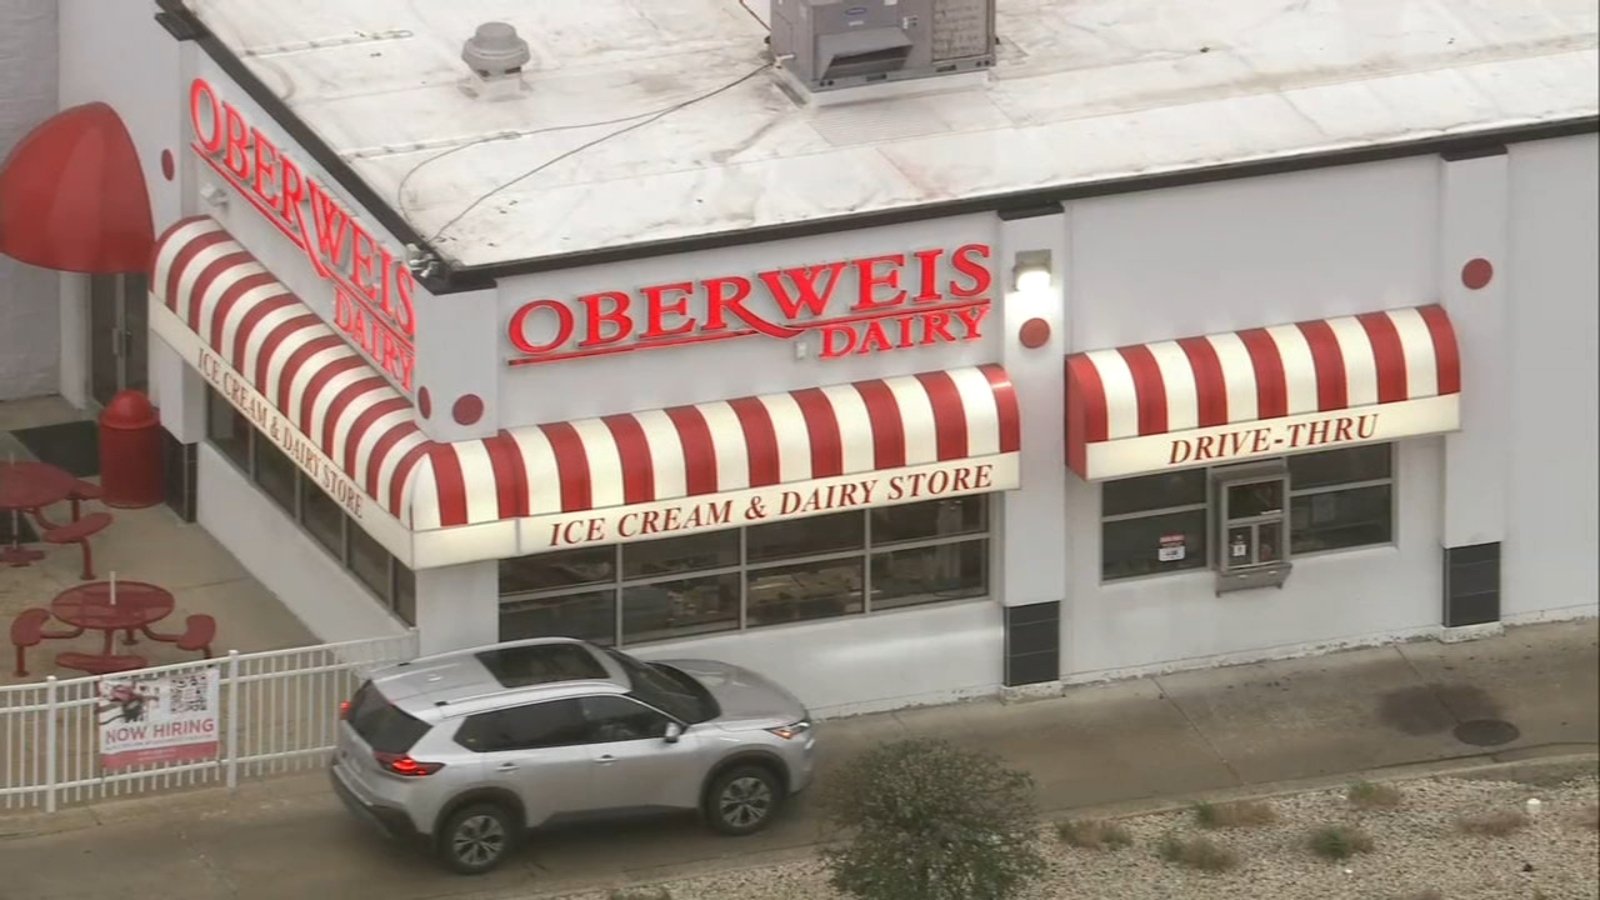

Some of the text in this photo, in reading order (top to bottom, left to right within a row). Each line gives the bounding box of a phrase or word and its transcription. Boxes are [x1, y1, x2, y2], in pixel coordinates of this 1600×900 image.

[189, 78, 416, 336] OBERWEIS
[333, 283, 416, 392] DAIRY
[507, 243, 992, 354] OBERWEIS
[818, 306, 990, 359] DAIRY
[200, 349, 363, 519] ICE CREAM & DAIRY STORE
[1168, 413, 1379, 464] DRIVE-THRU
[549, 464, 994, 547] ICE CREAM & DAIRY STORE
[106, 725, 147, 744] NOW
[153, 718, 214, 738] HIRING
